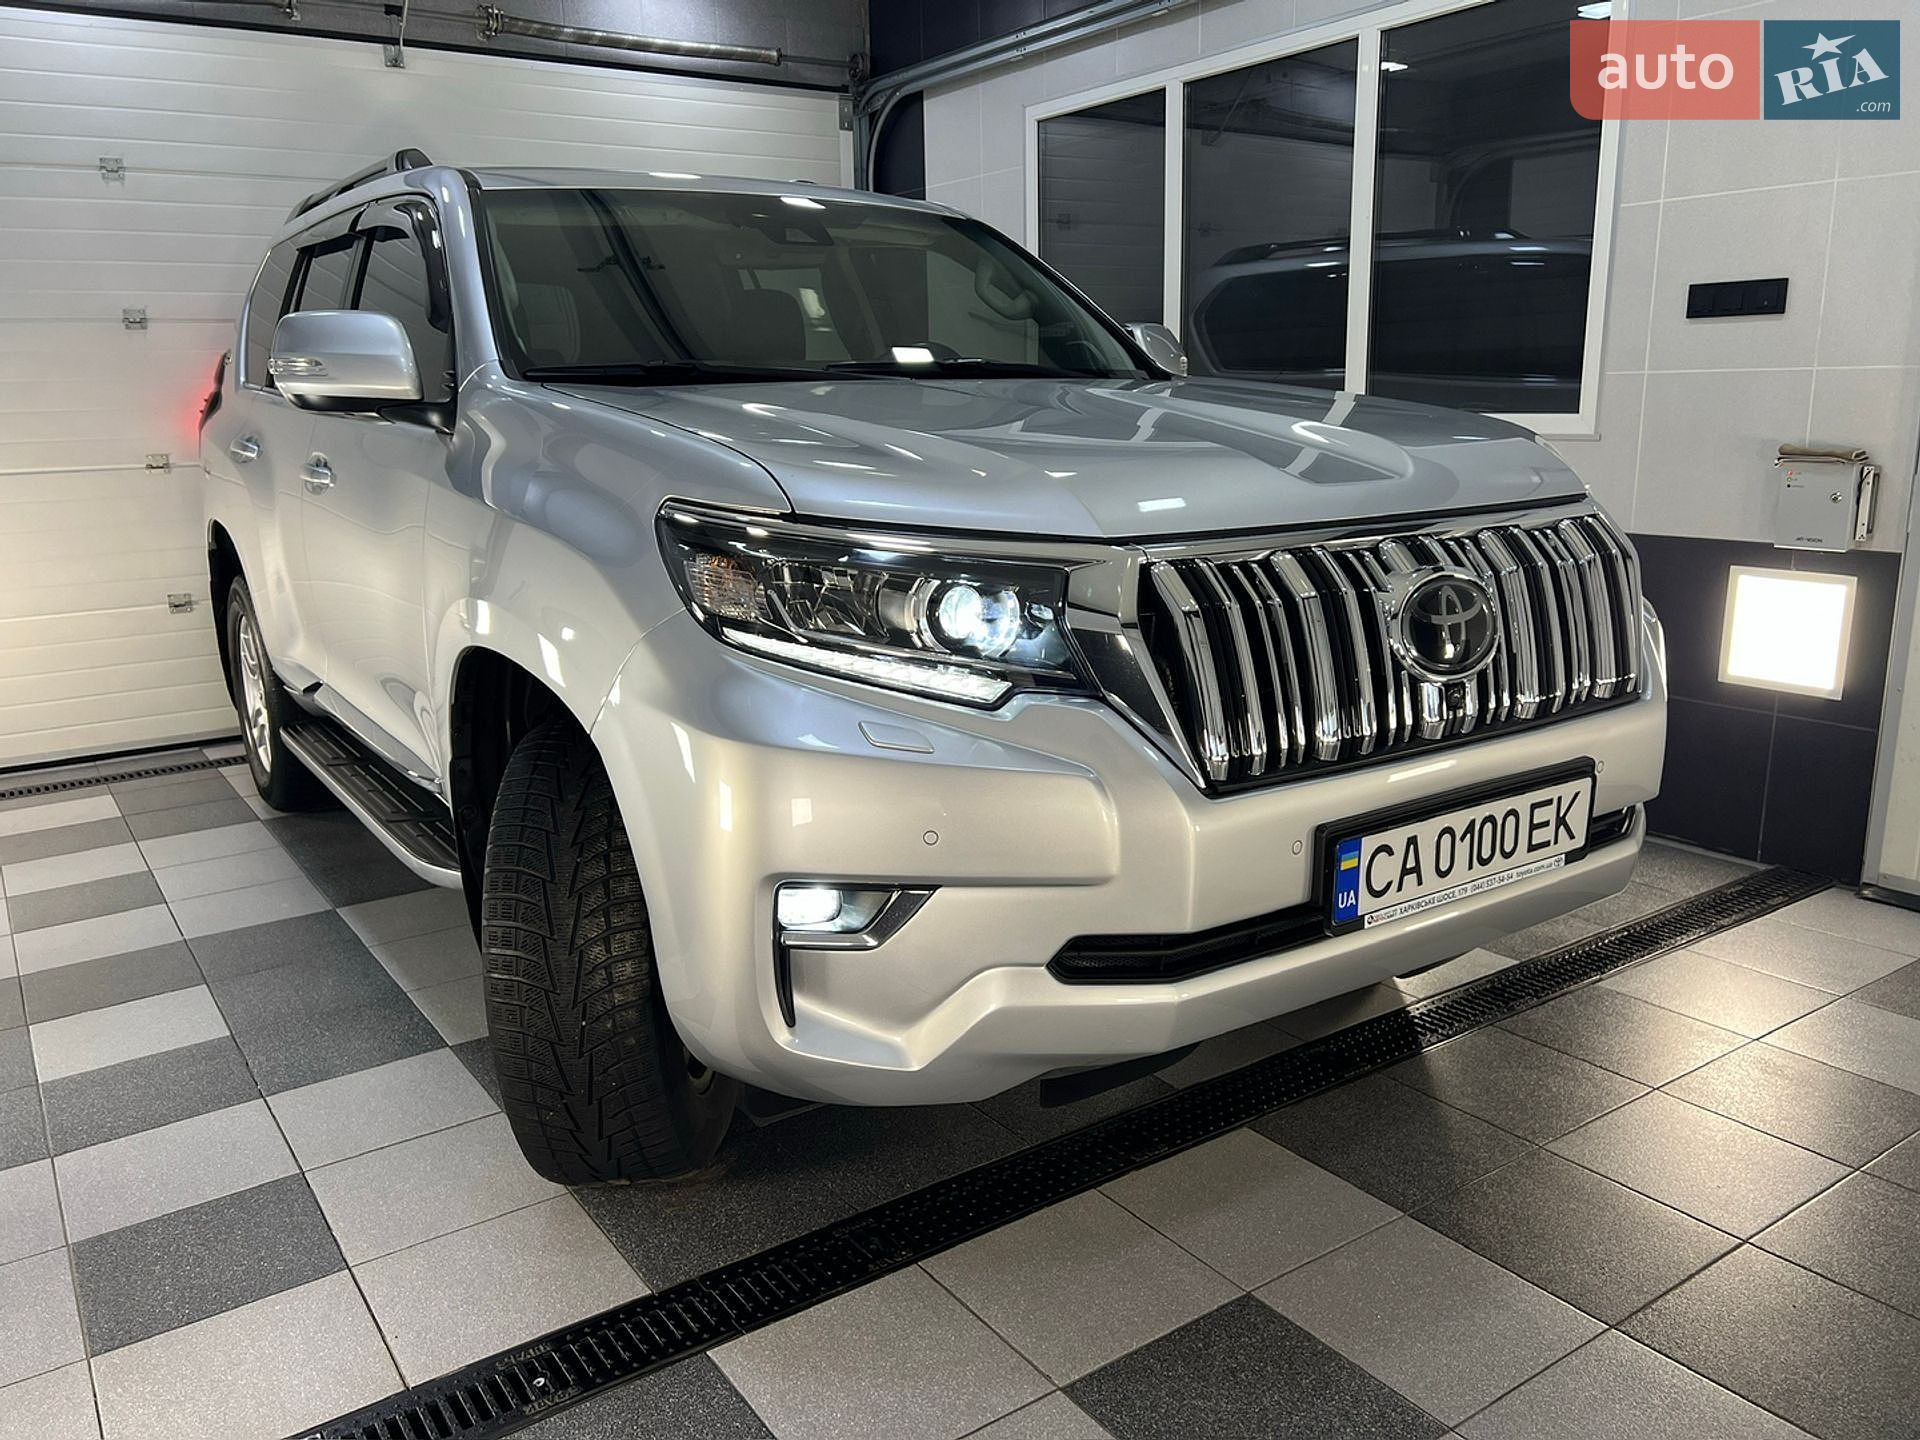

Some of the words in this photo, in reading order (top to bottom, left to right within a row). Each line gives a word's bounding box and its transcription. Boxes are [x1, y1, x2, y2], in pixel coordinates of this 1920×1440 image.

[1365, 834, 1424, 899] CA
[1434, 807, 1520, 879] 0100
[1527, 790, 1582, 853] EK
[1338, 889, 1357, 909] UA
